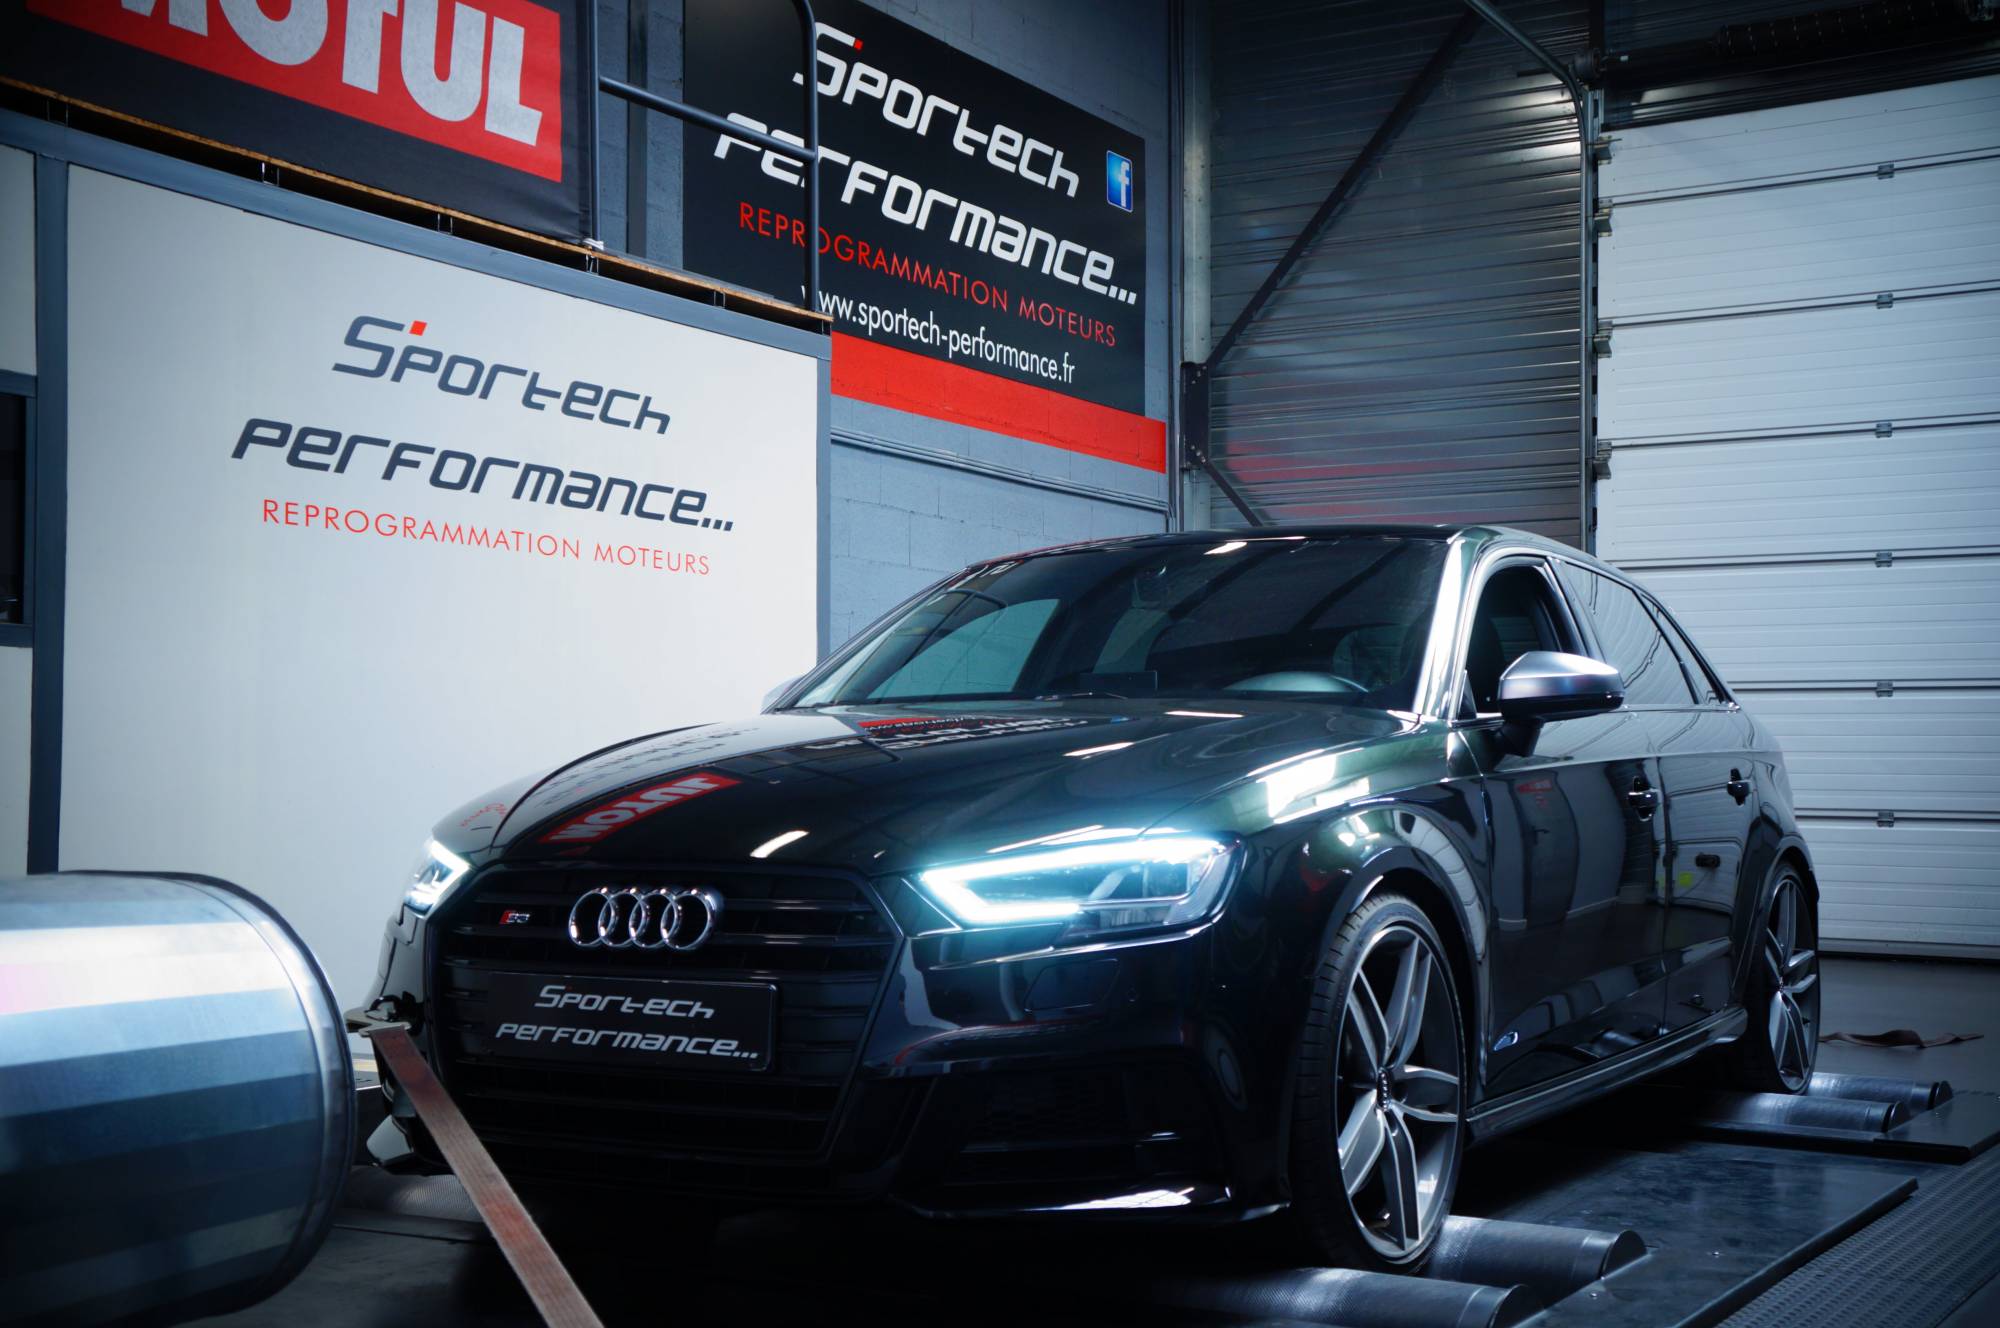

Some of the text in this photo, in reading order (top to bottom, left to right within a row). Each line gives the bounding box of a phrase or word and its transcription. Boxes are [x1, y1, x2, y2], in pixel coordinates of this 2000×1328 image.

[121, 0, 543, 146] OTUL
[800, 284, 1076, 385] ww.sportech-performance.fr
[1019, 295, 1116, 347] MOTEURS
[262, 498, 710, 576] REPROGRAMMATION MOTEURS
